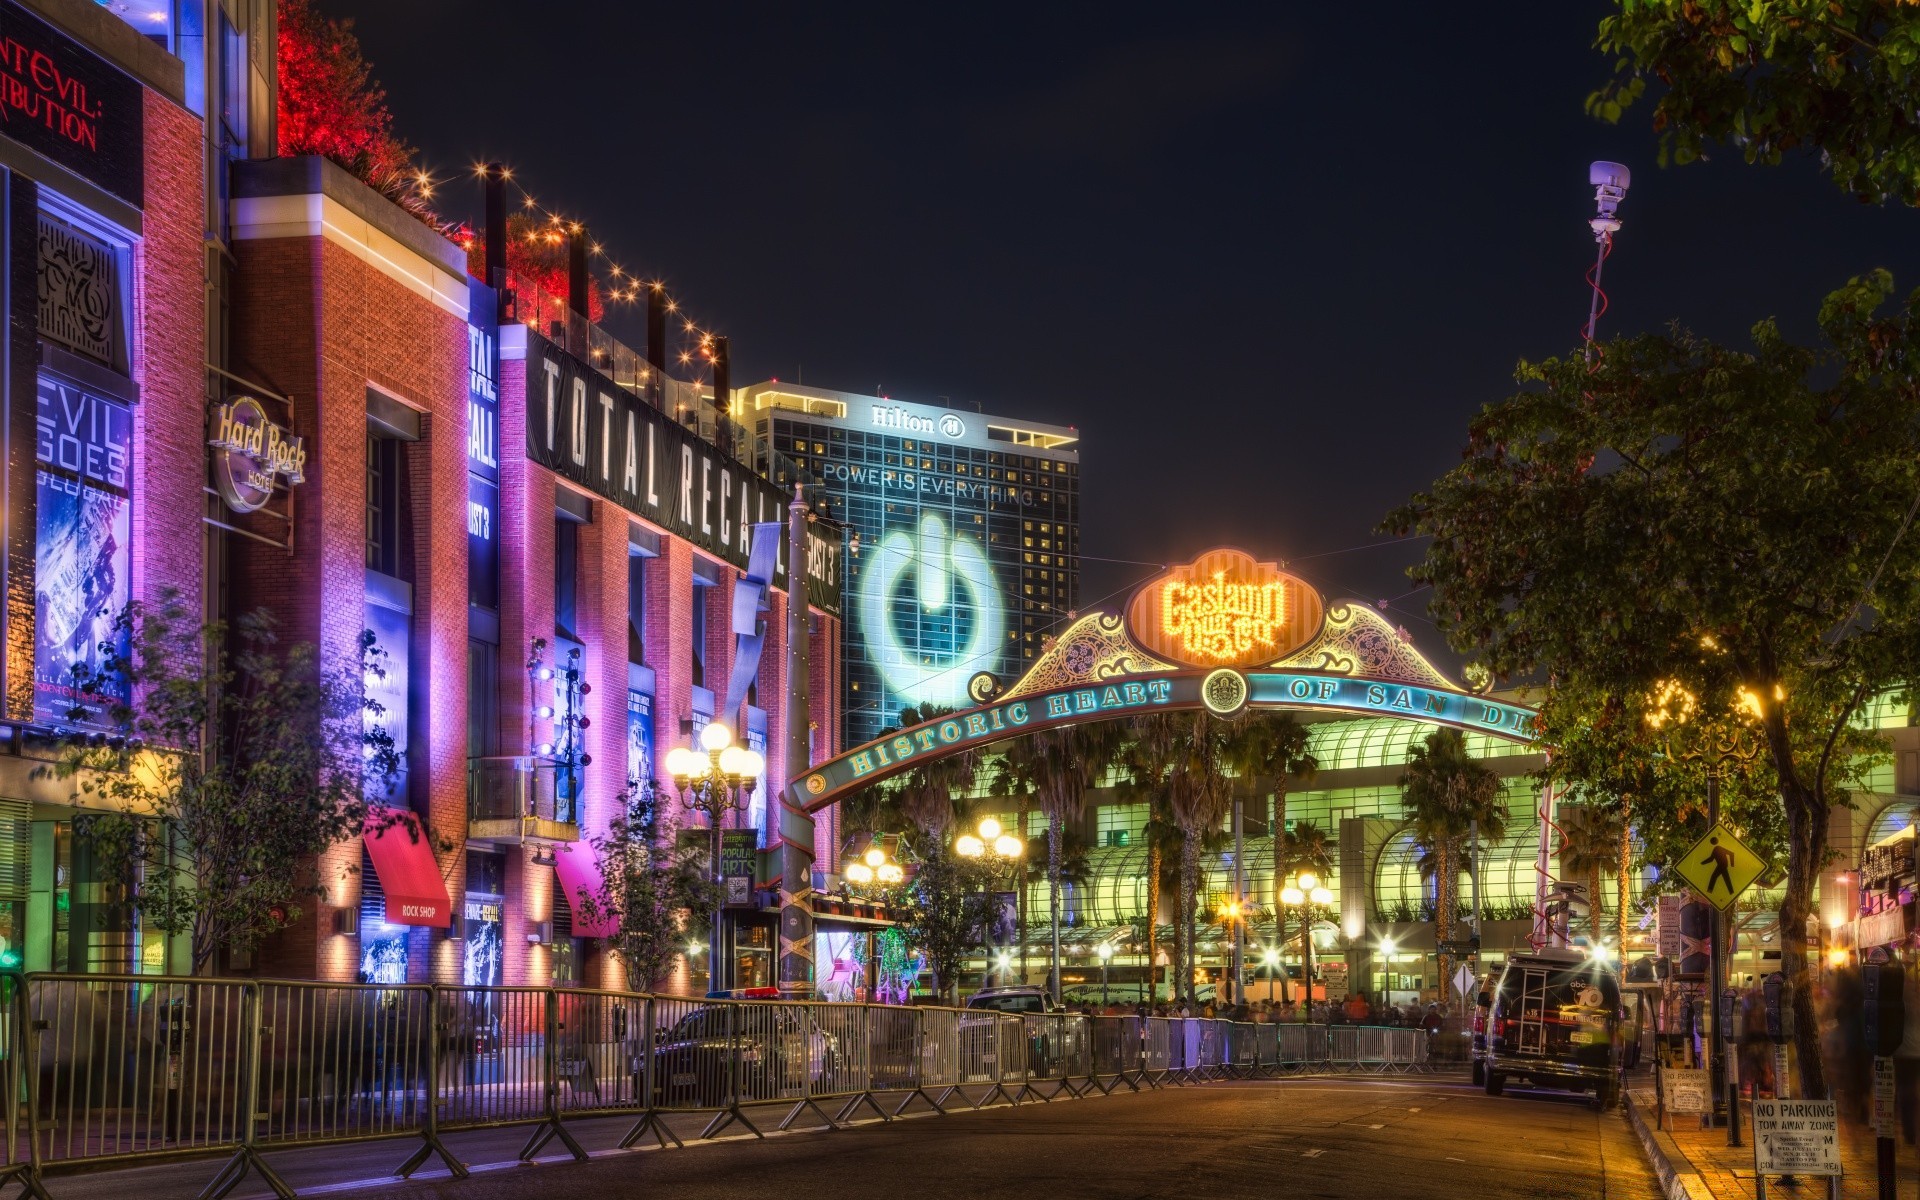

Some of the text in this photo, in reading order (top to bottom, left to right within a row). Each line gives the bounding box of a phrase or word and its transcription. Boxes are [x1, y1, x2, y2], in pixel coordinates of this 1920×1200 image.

[30, 51, 102, 119] EVIL:
[544, 357, 658, 508] TOTAL
[872, 405, 935, 433] Hilton
[219, 403, 306, 483] Hard Rock
[248, 470, 274, 491] HOTEL
[823, 463, 1038, 508] POWER IS EVERYTHING.
[828, 545, 834, 587] 3
[849, 702, 1030, 778] HISTORIC
[1048, 681, 1169, 717] HEART
[1290, 679, 1336, 700] OF
[1368, 685, 1447, 714] SAN
[721, 860, 756, 876] ARTS
[402, 905, 436, 918] ROCK SHOP
[1570, 981, 1586, 989] abc
[1757, 1104, 1834, 1117] NO PARKING
[1759, 1121, 1836, 1131] TOW AWAY ZONE
